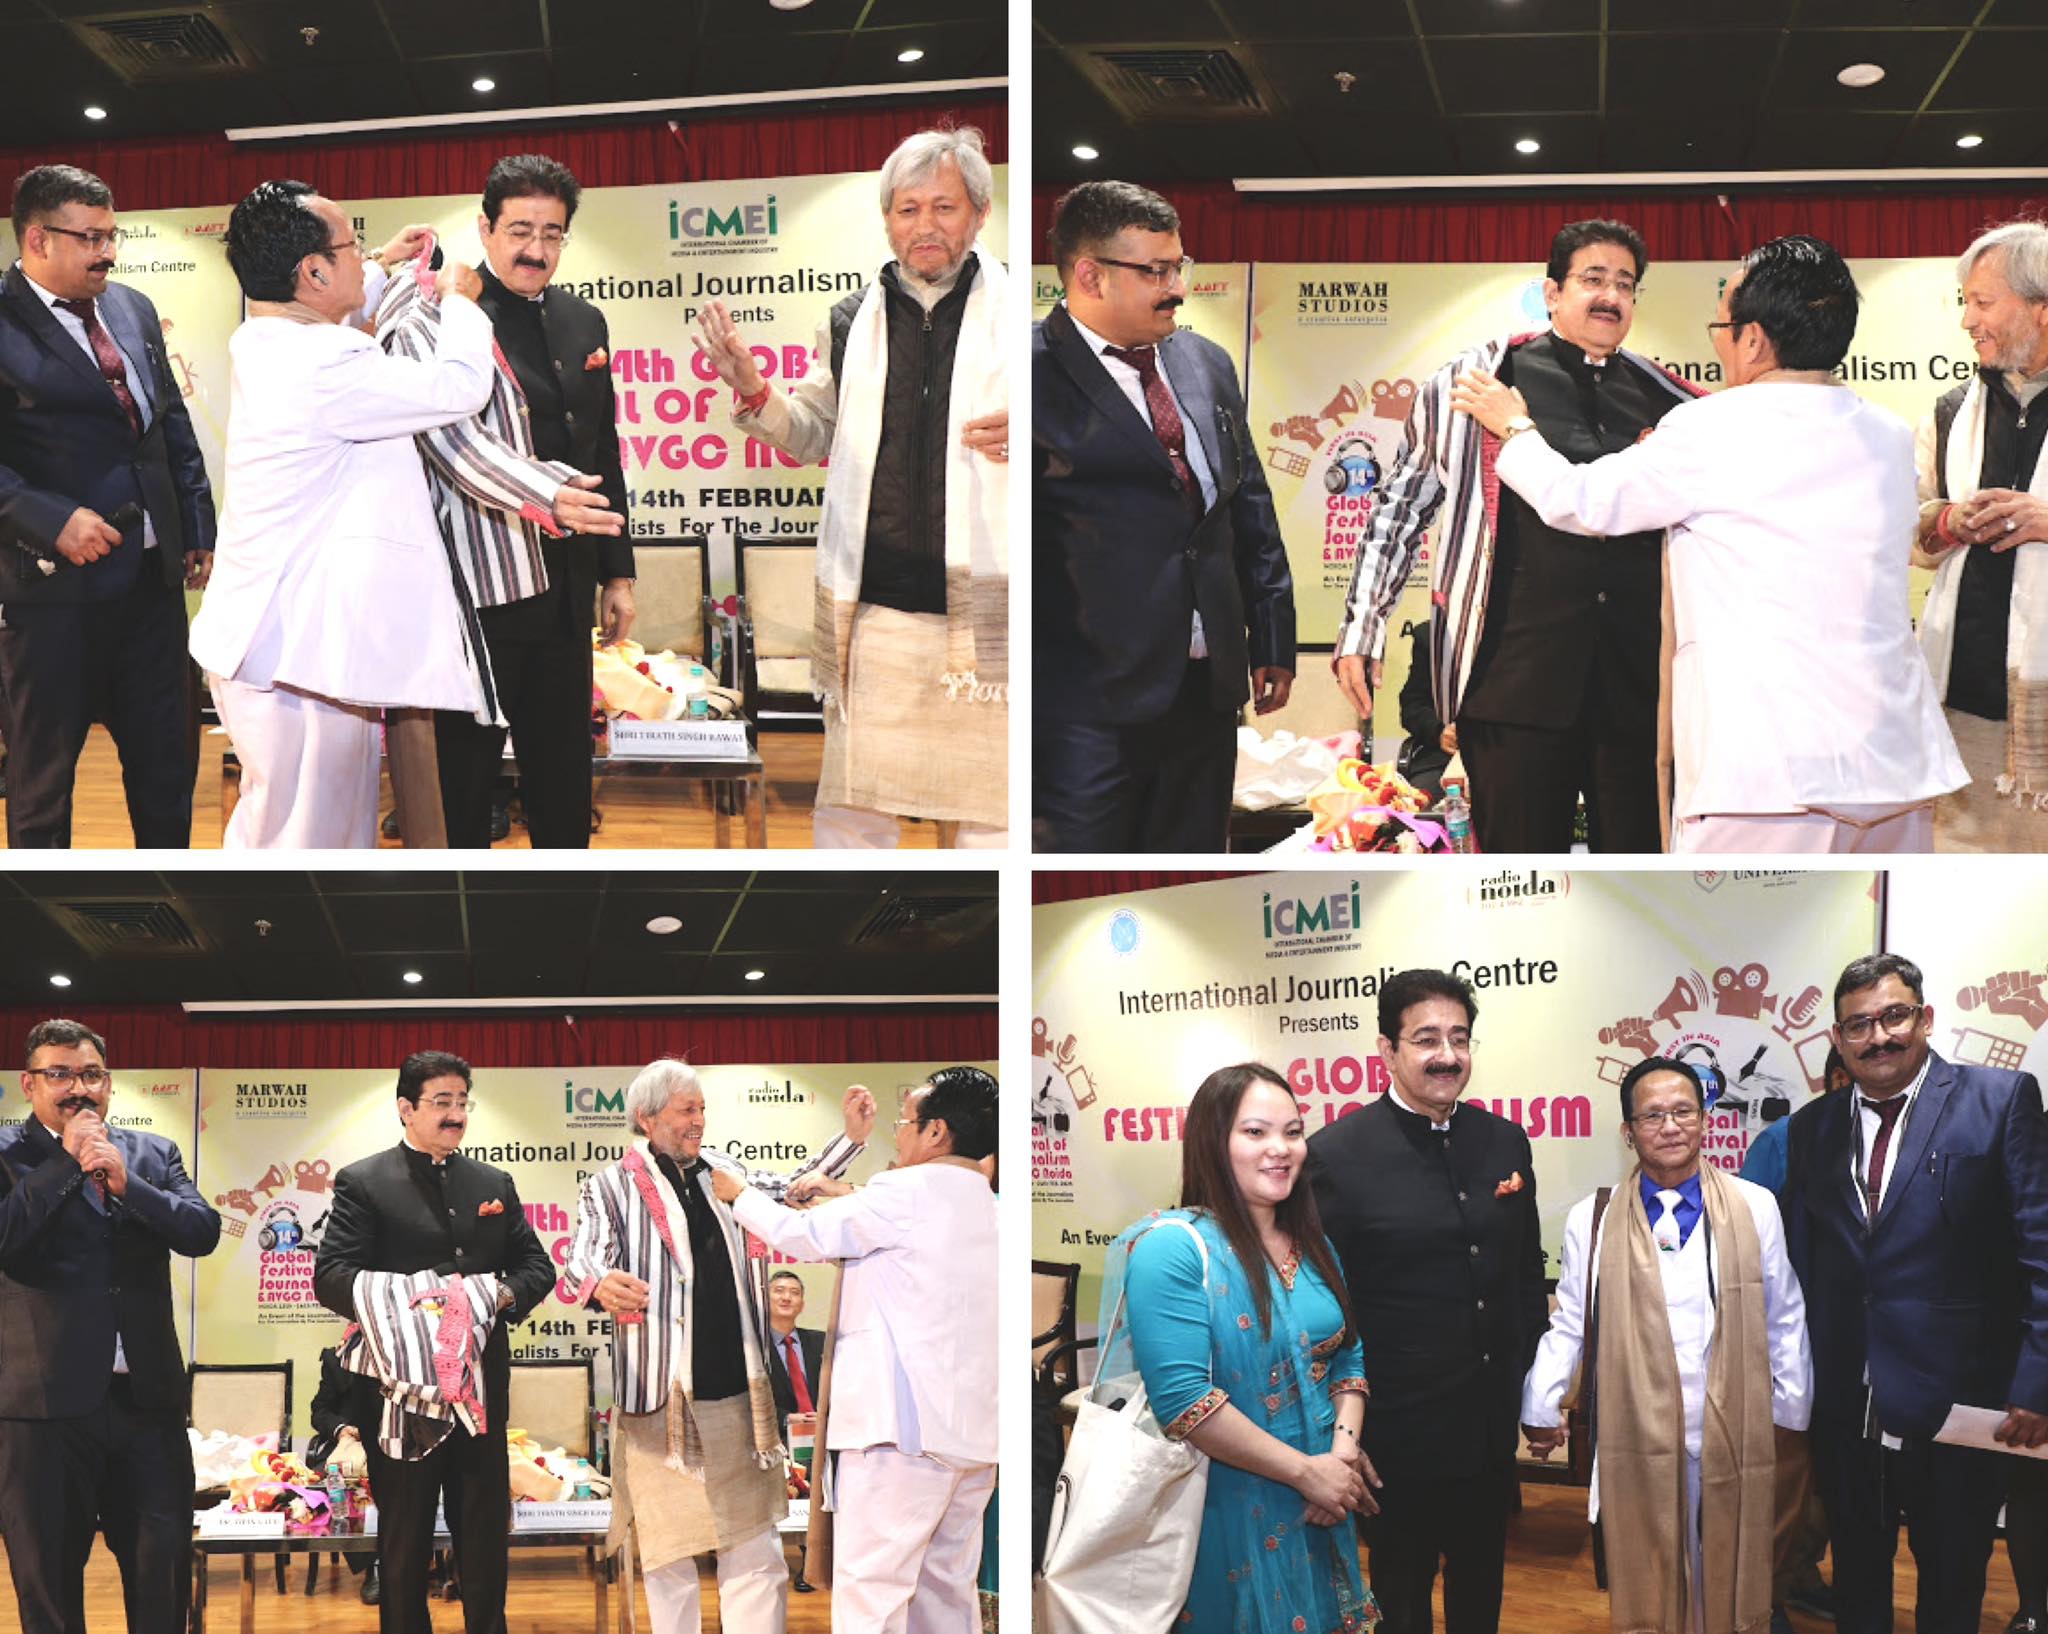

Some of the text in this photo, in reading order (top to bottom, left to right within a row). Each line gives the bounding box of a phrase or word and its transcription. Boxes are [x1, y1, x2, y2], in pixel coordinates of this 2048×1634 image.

[151, 260, 196, 273] Centre
[553, 268, 862, 300] national Journalism
[1298, 282, 1388, 297] MARWAH
[1298, 299, 1388, 312] STUDIOS
[685, 305, 773, 324] Pents
[680, 518, 714, 534] For
[722, 516, 762, 534] The
[1119, 957, 1558, 1016] International Journal Centre
[1279, 1012, 1359, 1034] Presents
[236, 1083, 307, 1096] MARWAH
[566, 1081, 628, 1113] iCM
[236, 1096, 307, 1108] STUDIOS
[110, 1115, 152, 1127] Centre
[1054, 1137, 1067, 1150] of
[1061, 1229, 1081, 1245] An
[260, 1249, 313, 1264] Global
[528, 1320, 575, 1336] 14th
[571, 1343, 600, 1358] For
